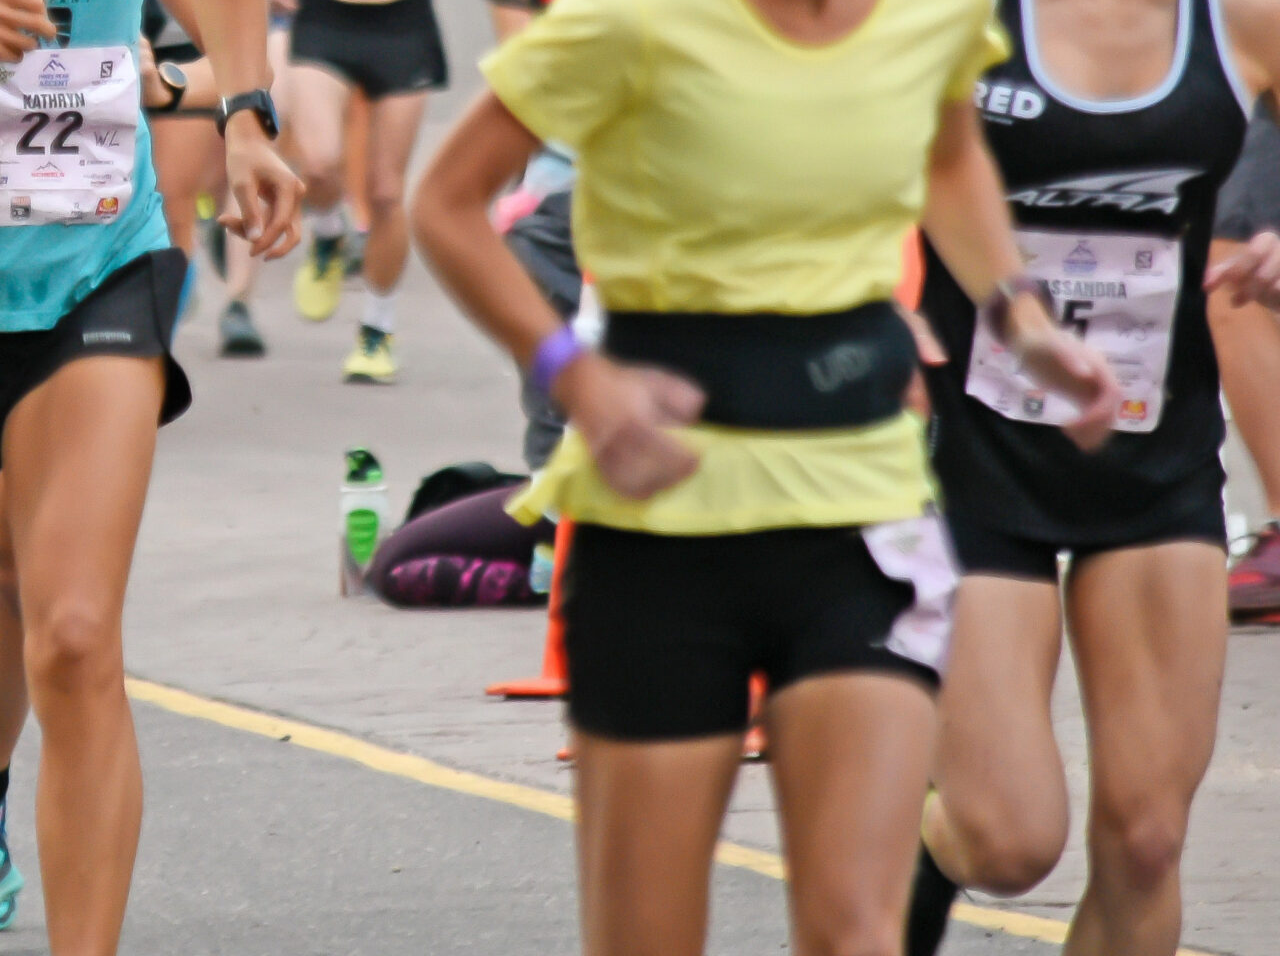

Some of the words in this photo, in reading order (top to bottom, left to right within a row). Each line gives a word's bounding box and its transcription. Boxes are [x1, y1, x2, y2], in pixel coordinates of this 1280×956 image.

[23, 93, 86, 109] KATHRYN
[16, 111, 84, 156] 22
[1038, 279, 1127, 299] ASSANDRA
[1061, 299, 1094, 338] 5
